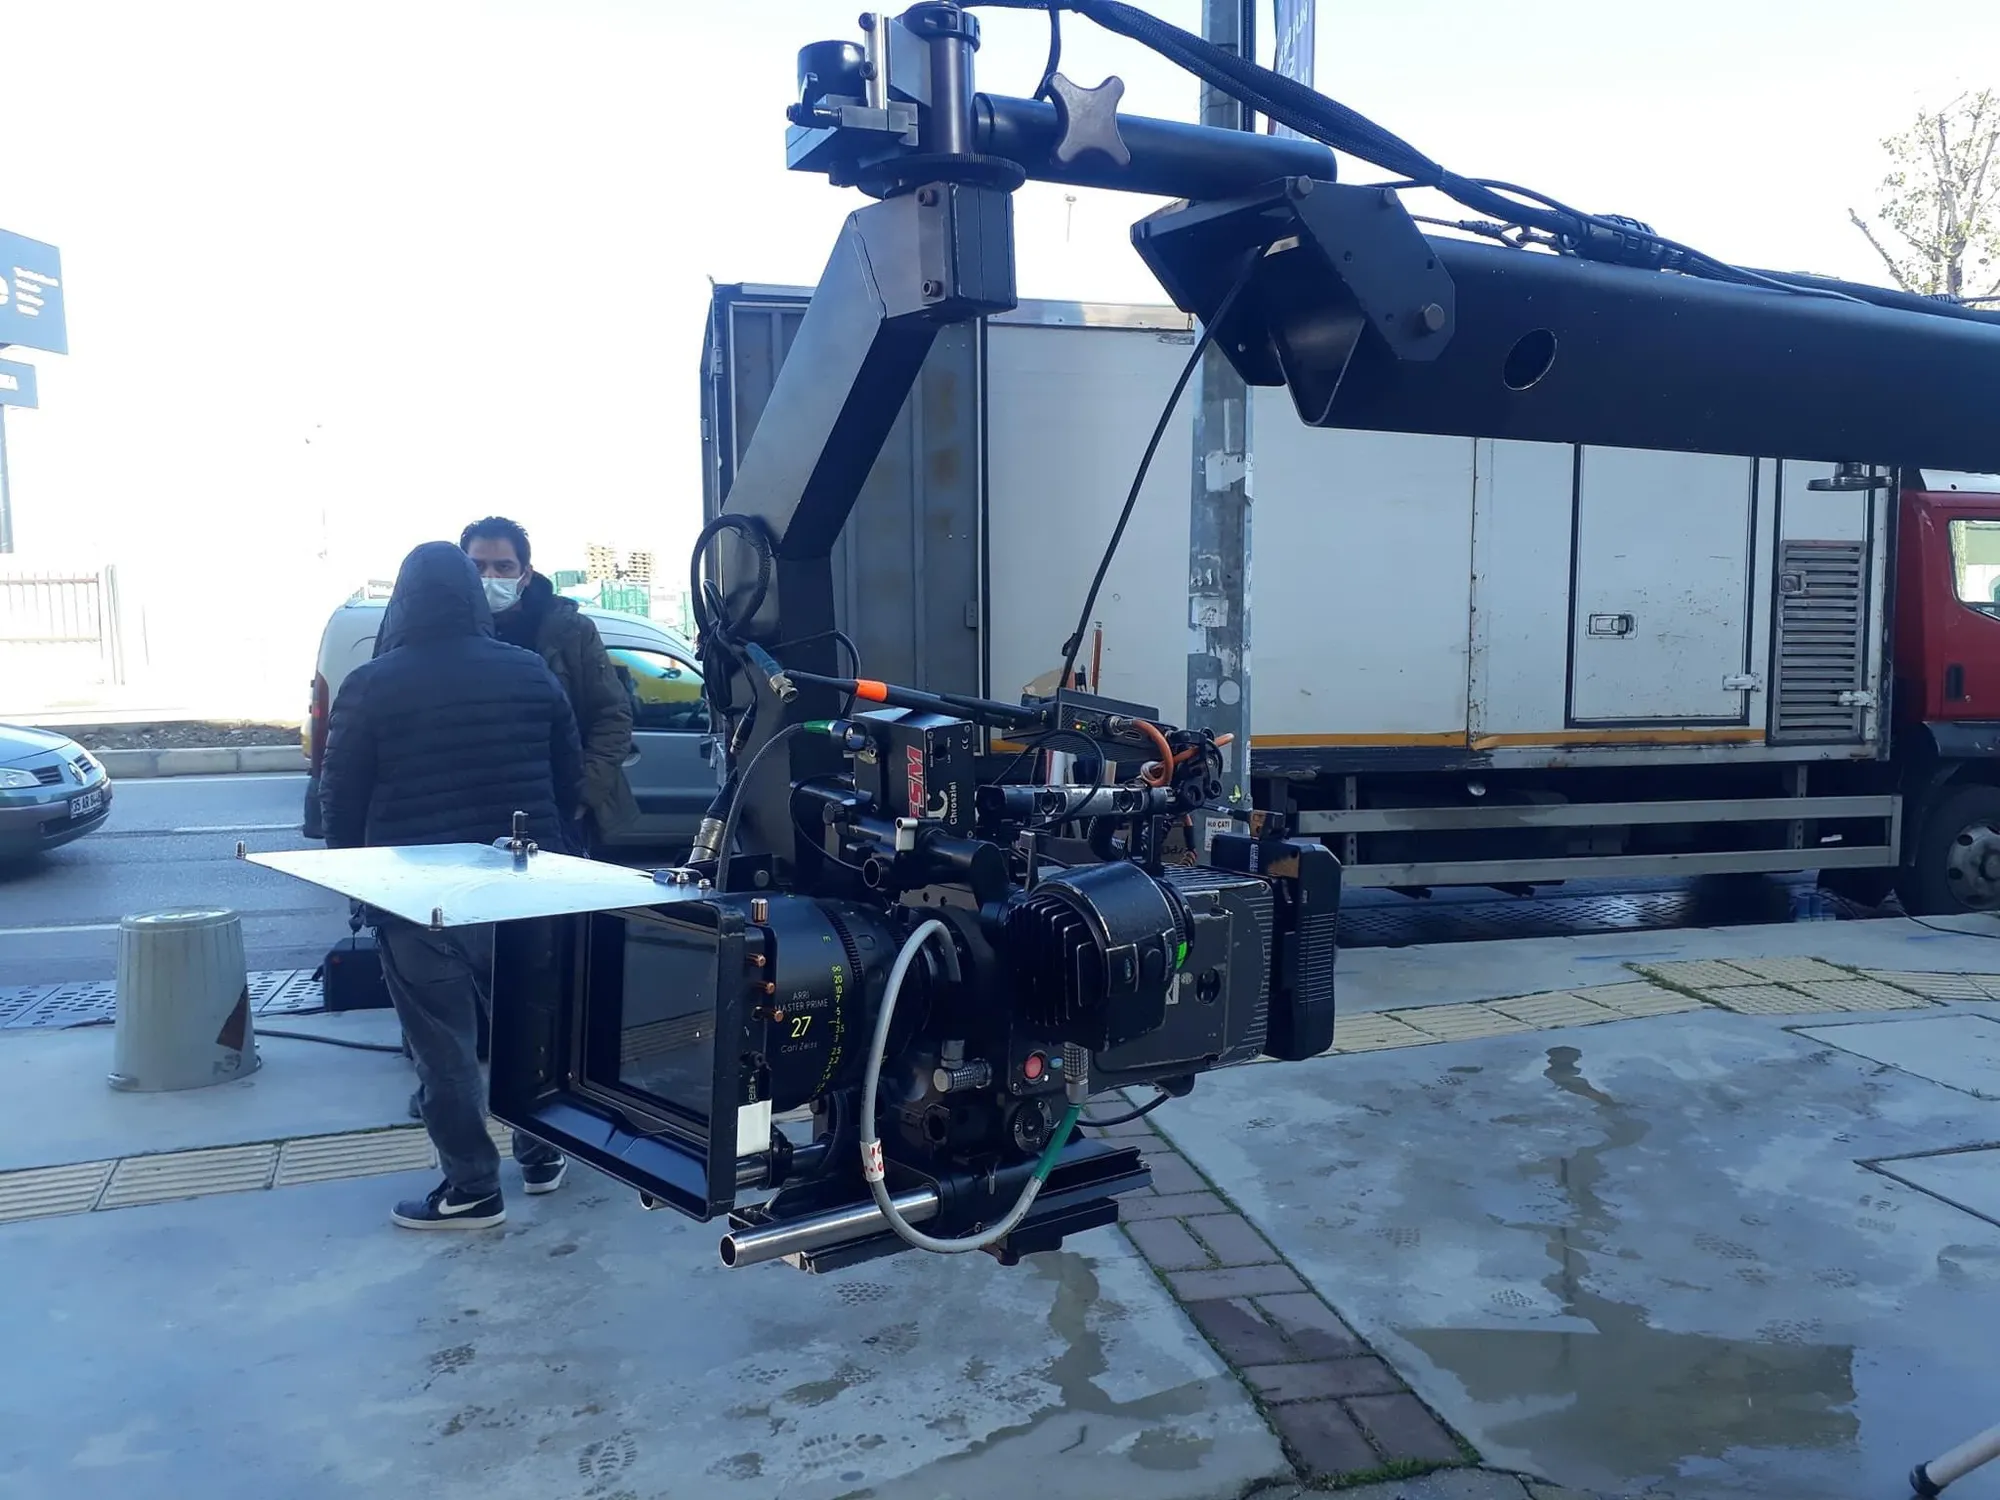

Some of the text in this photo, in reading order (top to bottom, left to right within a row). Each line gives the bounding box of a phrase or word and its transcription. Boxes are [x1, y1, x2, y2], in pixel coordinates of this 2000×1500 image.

[833, 974, 843, 984] 20
[805, 998, 829, 1010] PRIME
[791, 1016, 812, 1038] 27
